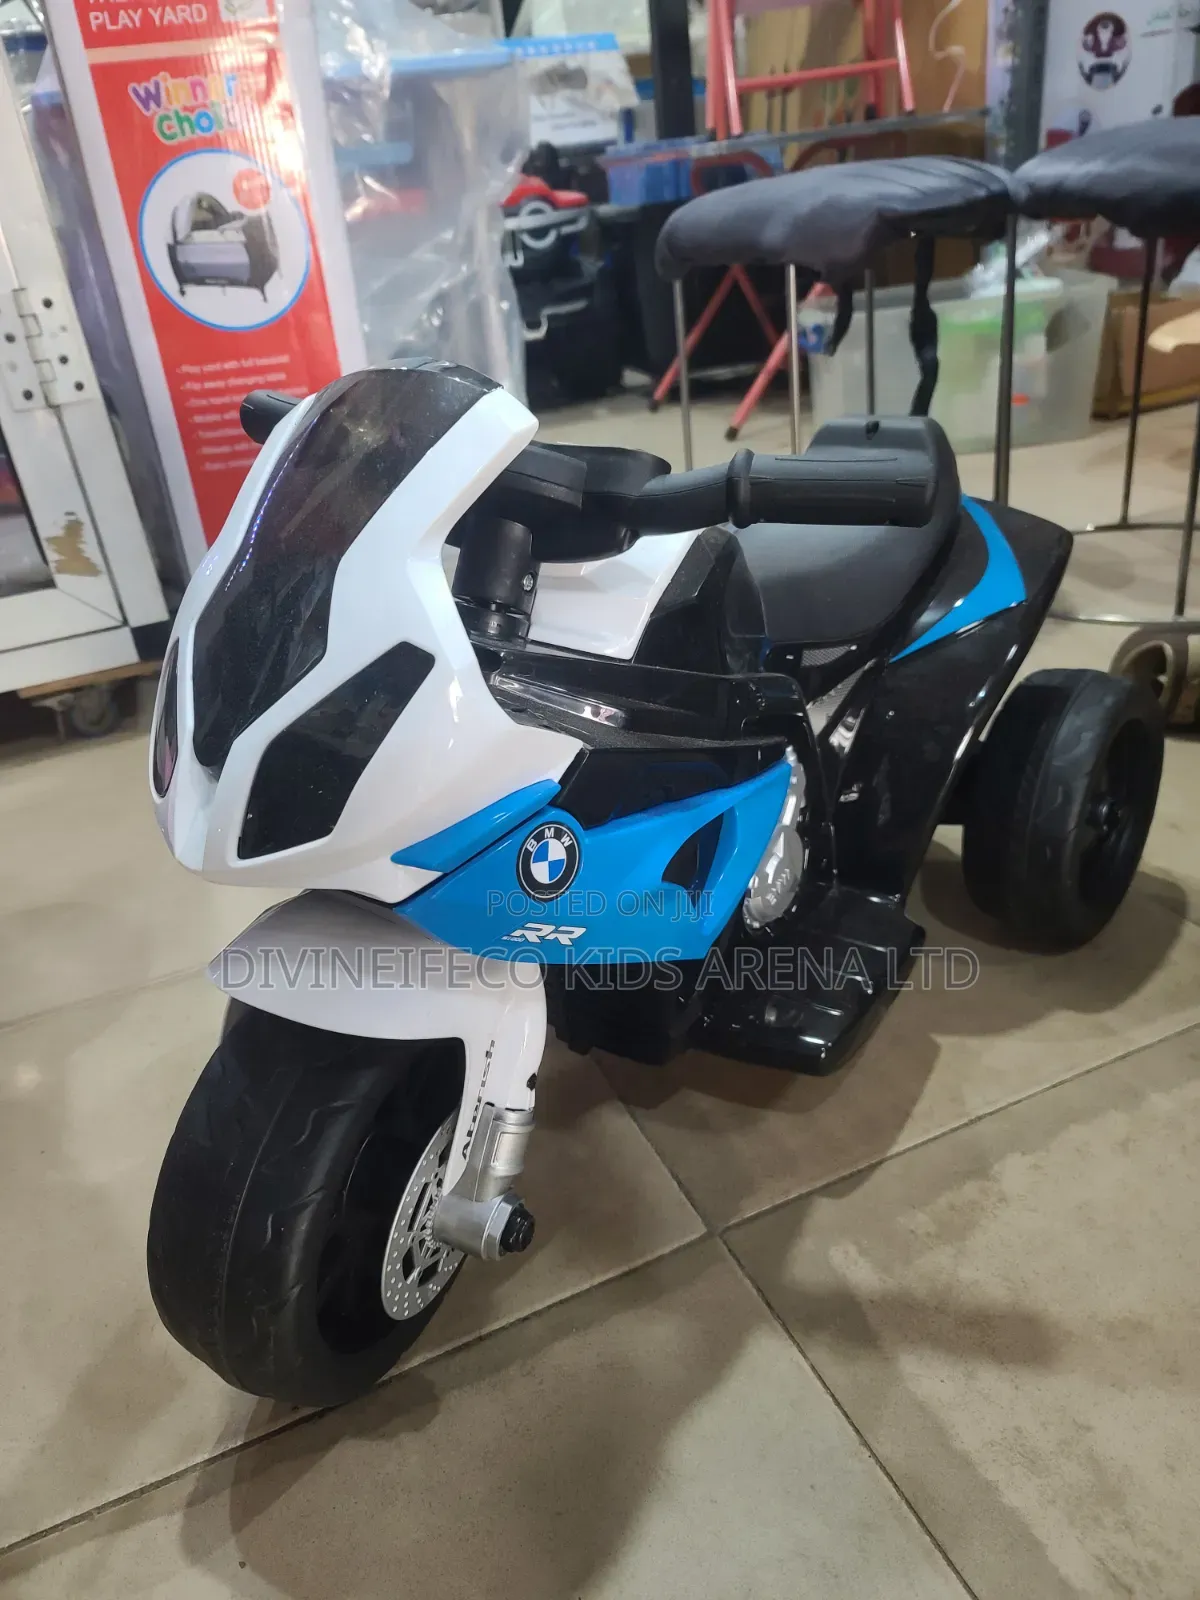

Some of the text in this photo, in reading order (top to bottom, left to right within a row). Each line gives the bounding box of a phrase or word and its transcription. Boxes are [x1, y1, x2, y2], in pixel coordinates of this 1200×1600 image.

[88, 4, 208, 32] PLAY YARD
[526, 827, 573, 852] BMW
[510, 922, 587, 946] RR
